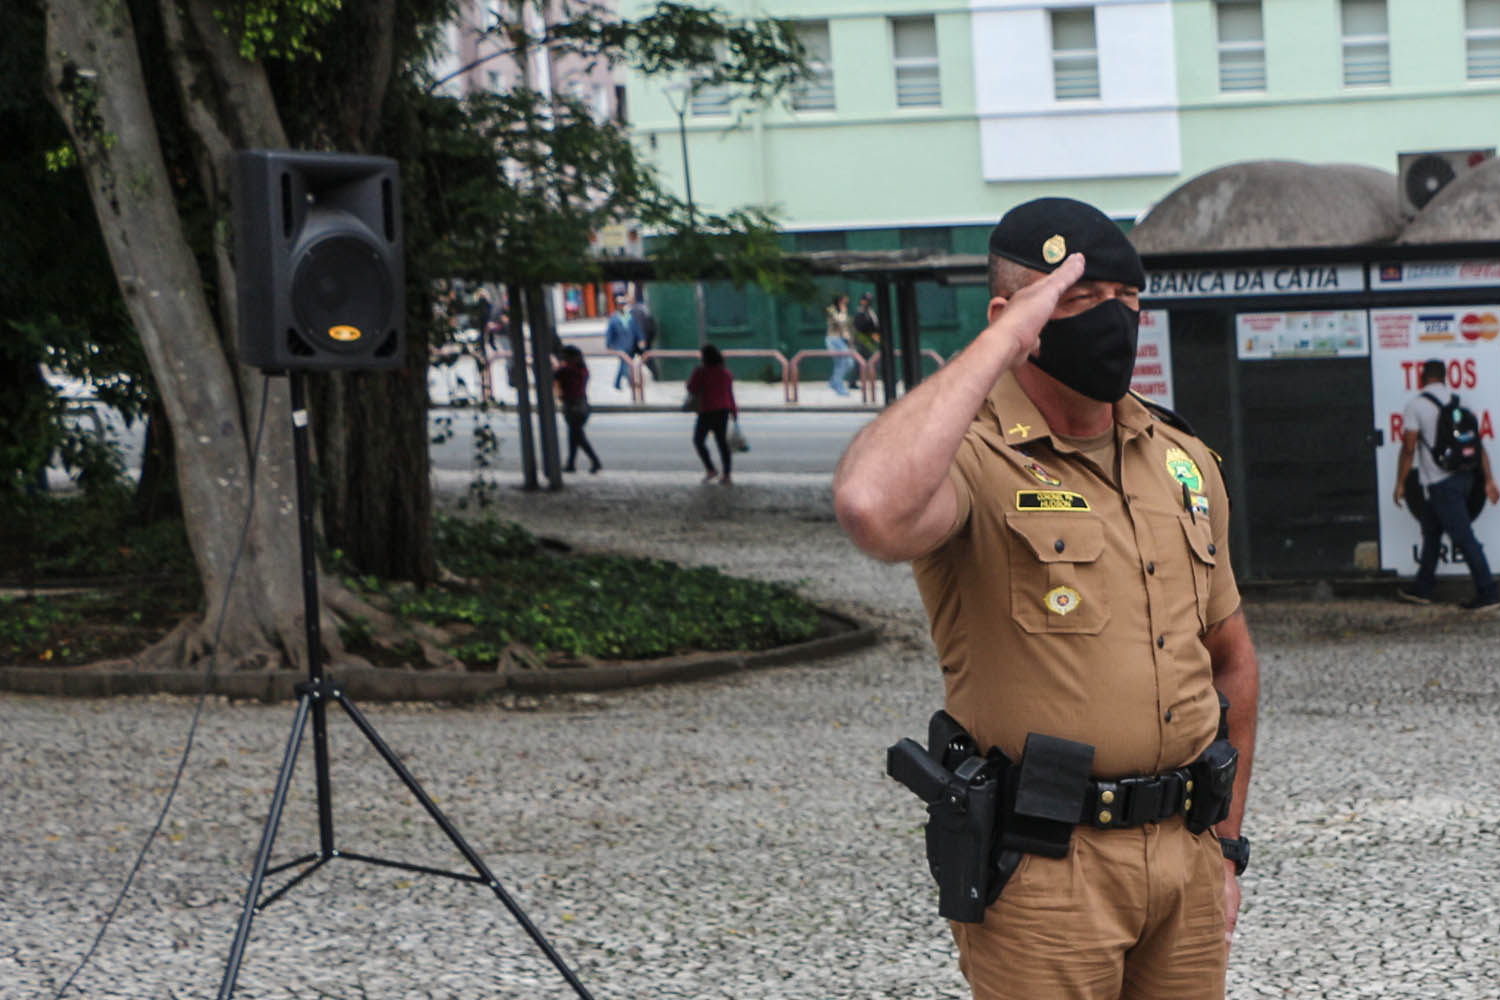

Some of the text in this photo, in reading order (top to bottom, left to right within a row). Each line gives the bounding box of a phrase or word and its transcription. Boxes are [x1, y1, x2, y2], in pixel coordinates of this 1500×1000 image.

[1150, 271, 1225, 294] BANCA
[1233, 269, 1265, 291] DA
[1401, 358, 1477, 391] TEOS
